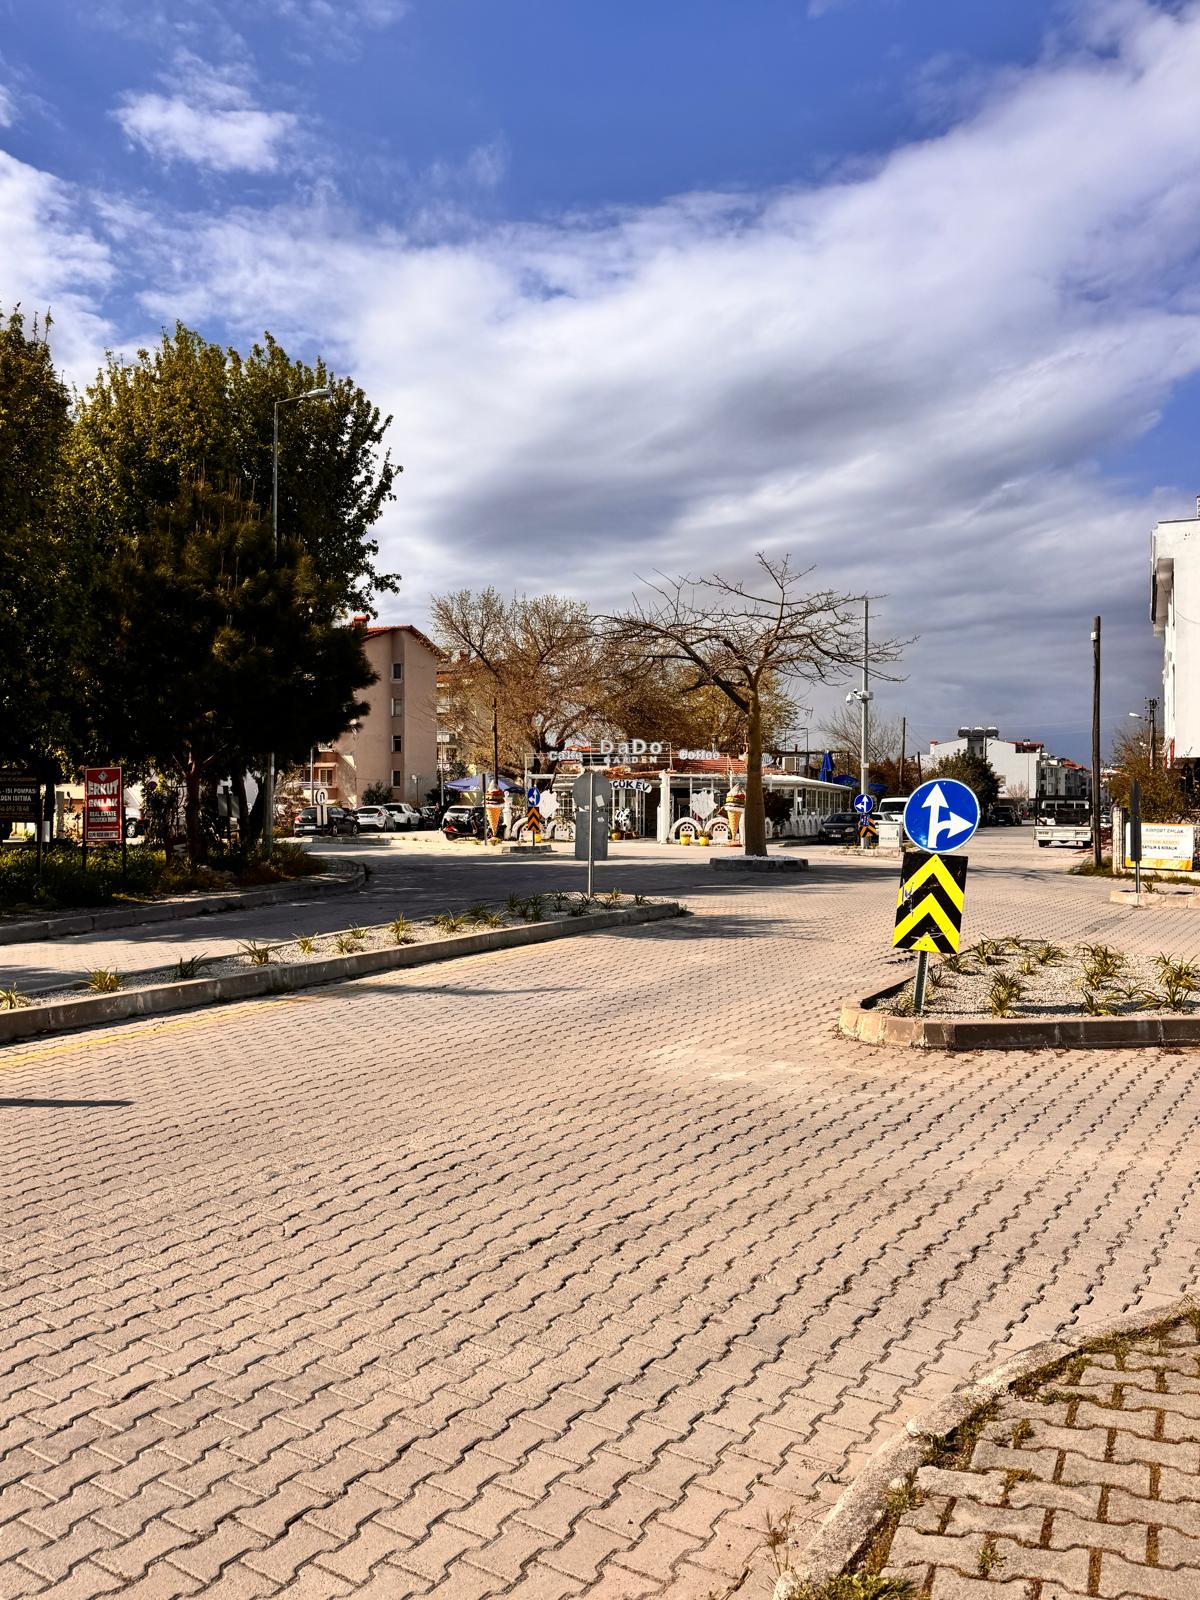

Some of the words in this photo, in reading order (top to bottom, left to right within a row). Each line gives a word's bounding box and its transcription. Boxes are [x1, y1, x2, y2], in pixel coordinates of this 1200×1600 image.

[601, 739, 662, 755] DaDo
[549, 751, 583, 761] Cake
[604, 756, 657, 764] GARDEN
[679, 749, 720, 760] Coffee
[88, 779, 118, 795] ERKUT
[610, 780, 633, 789] ÇÜK
[636, 781, 650, 791] EV
